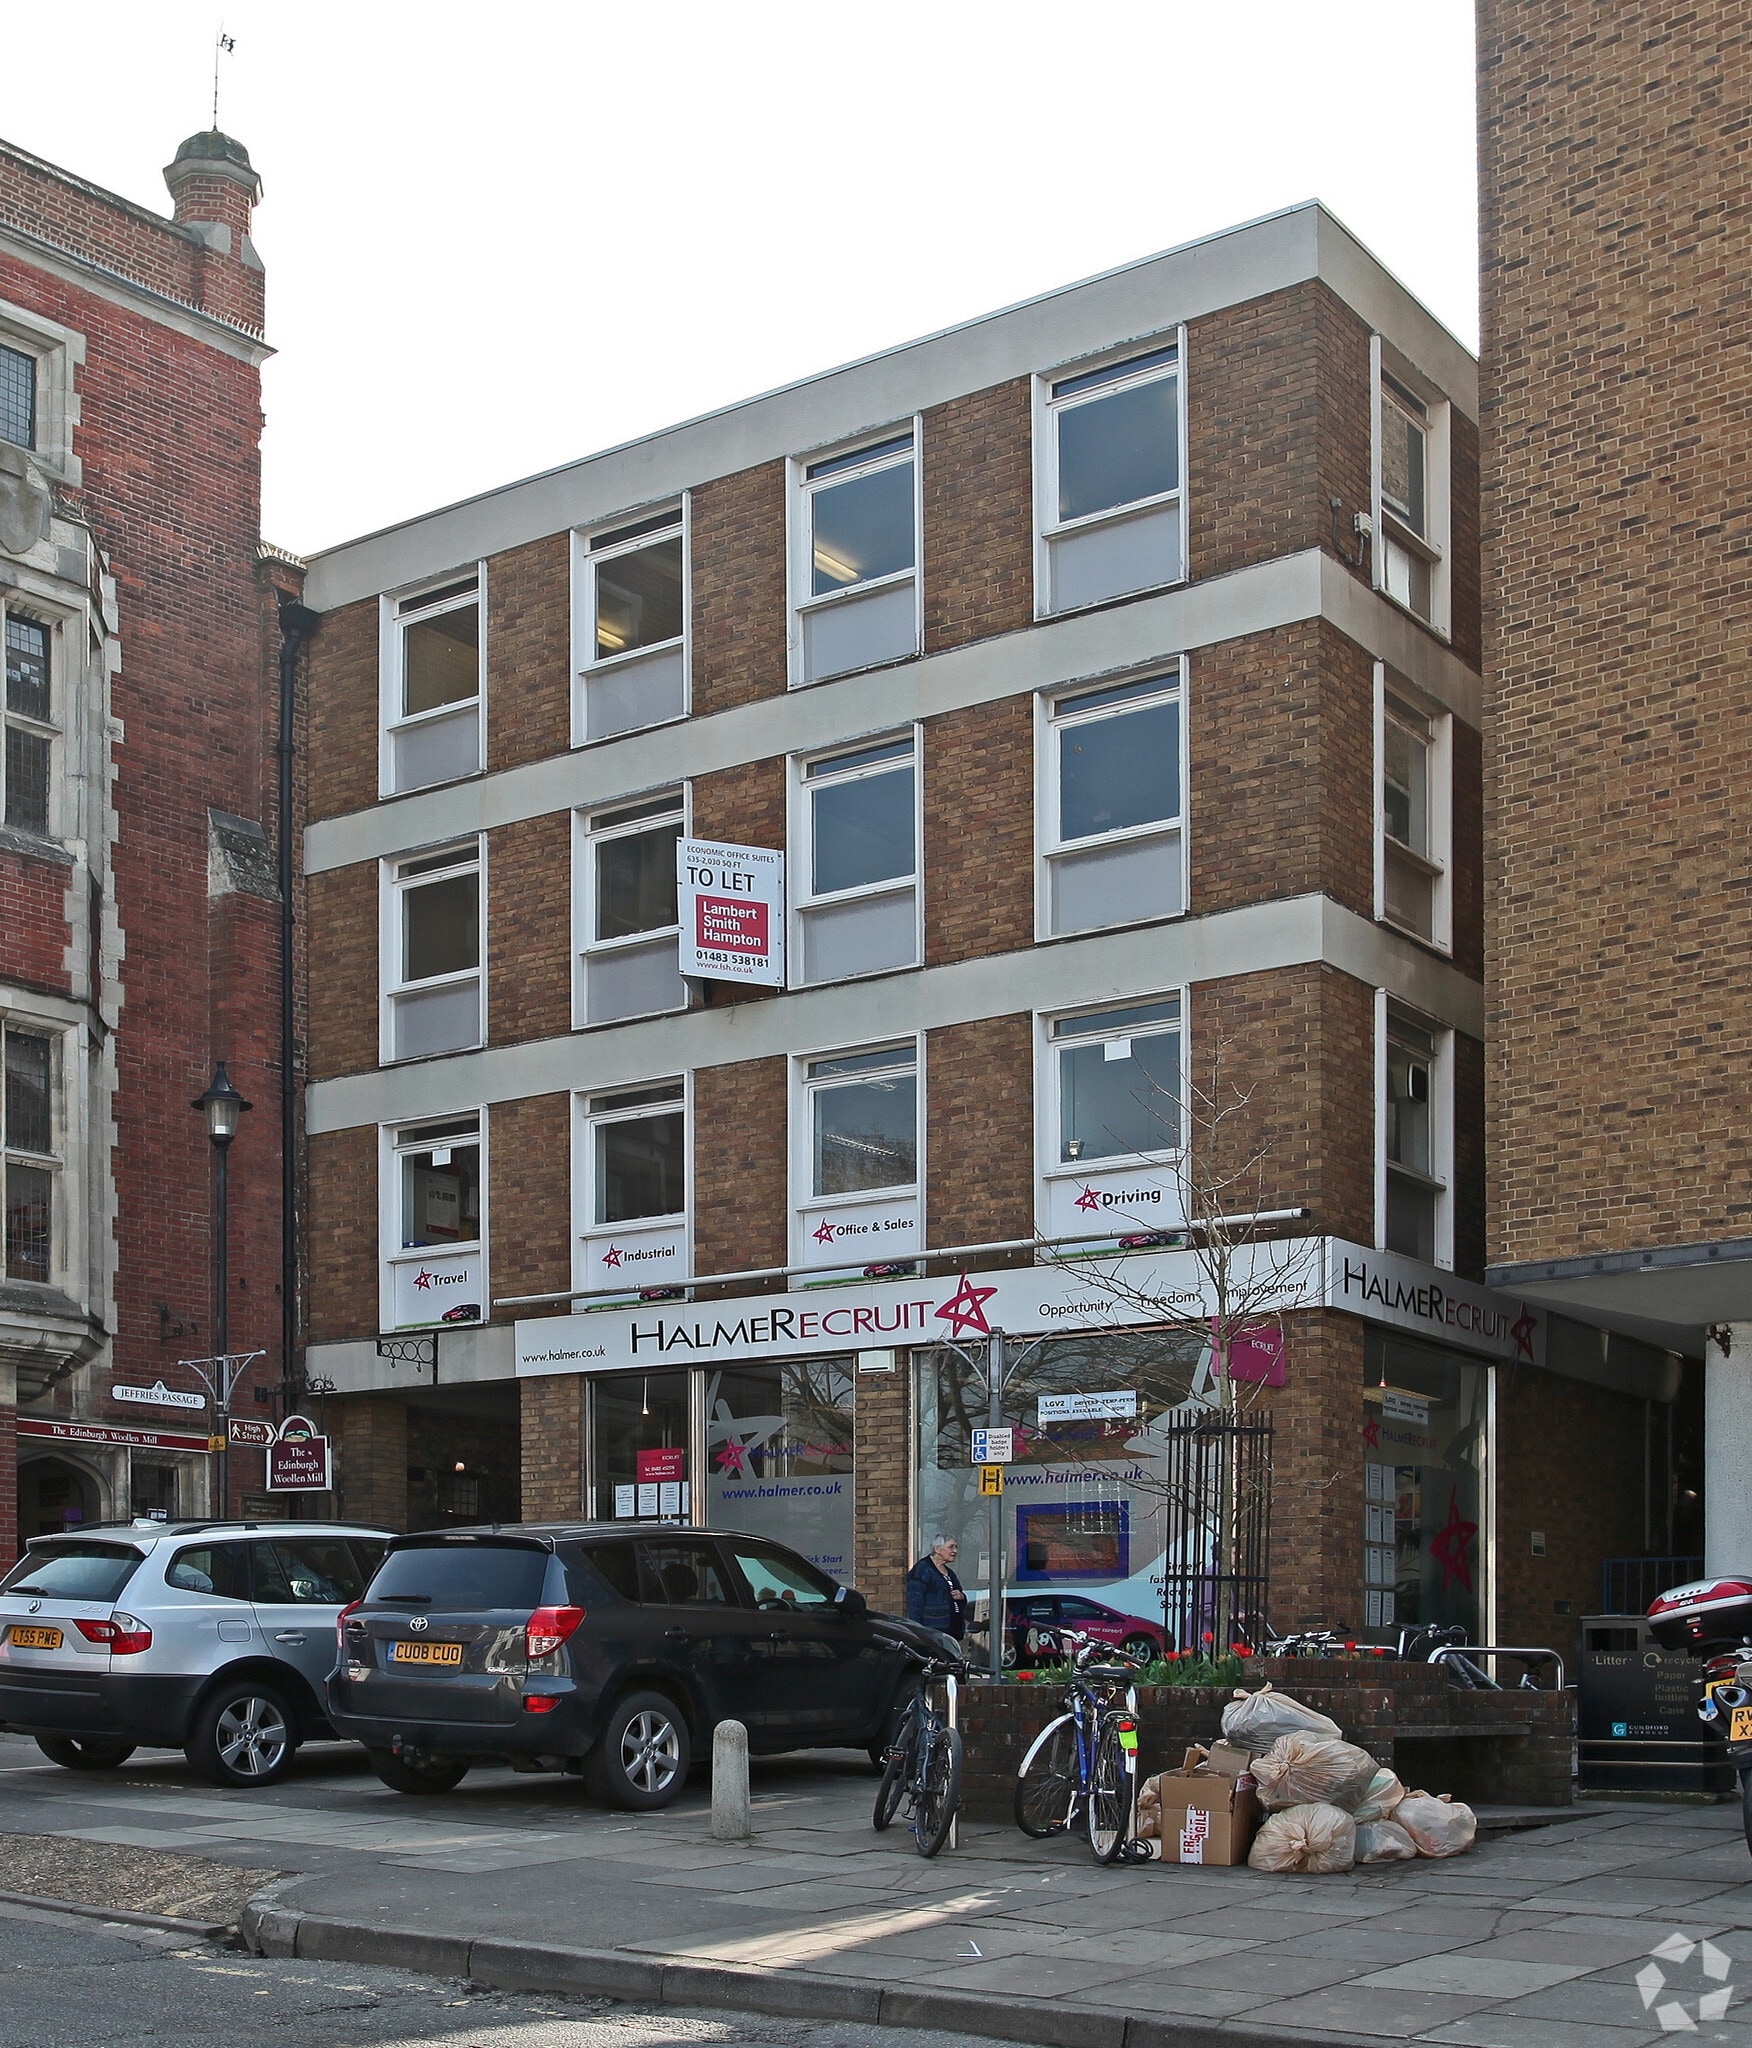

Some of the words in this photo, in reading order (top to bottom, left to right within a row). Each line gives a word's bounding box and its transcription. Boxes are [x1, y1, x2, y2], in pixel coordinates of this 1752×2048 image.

[686, 845, 725, 857] ECONOMIC
[726, 850, 750, 860] OFFICE
[751, 854, 775, 864] SUITES
[686, 866, 714, 887] TO
[721, 870, 755, 893] LET
[702, 900, 758, 920] Lambert
[703, 914, 741, 932] Smith
[703, 928, 762, 947] Hampton
[695, 950, 728, 963] 01483
[731, 955, 769, 968] 538181
[696, 961, 754, 974] www.lsh.co.uk
[1102, 1187, 1162, 1208] Driving
[835, 1221, 869, 1237] Office
[871, 1221, 881, 1232] &
[883, 1217, 915, 1231] Sales
[623, 1245, 677, 1263] Industrial
[432, 1270, 469, 1286] Travel
[1344, 1256, 1511, 1341] HALMERECRUIT
[521, 1345, 606, 1365] www.halmer.co.uk
[630, 1300, 935, 1354] HALMERECRUIT
[1038, 1298, 1114, 1319] Opportunity
[1139, 1290, 1196, 1308] Freedom
[1226, 1280, 1308, 1303] mprovement
[119, 1388, 160, 1401] JEFFRIES
[162, 1393, 199, 1406] PASSAGE
[1044, 1400, 1065, 1408] LGV2
[51, 1425, 67, 1436] The
[69, 1427, 108, 1441] Edinburgh
[110, 1431, 140, 1444] Woollen
[142, 1435, 158, 1445] Mill
[241, 1432, 265, 1442] Street
[244, 1424, 261, 1434] High
[290, 1447, 306, 1457] The
[277, 1459, 319, 1471] Edinburgh
[273, 1473, 306, 1484] Woollen
[306, 1472, 324, 1483] Mill
[721, 1481, 843, 1500] www.halmer.co.uk
[821, 1554, 843, 1563] Start
[12, 1629, 36, 1644] LT55
[396, 1644, 430, 1660] CU08
[1595, 1655, 1628, 1666] Litter
[1656, 1671, 1686, 1682] Paper
[1654, 1684, 1689, 1693] Plastic
[1654, 1693, 1689, 1702] bottles
[1659, 1706, 1685, 1715] Cans
